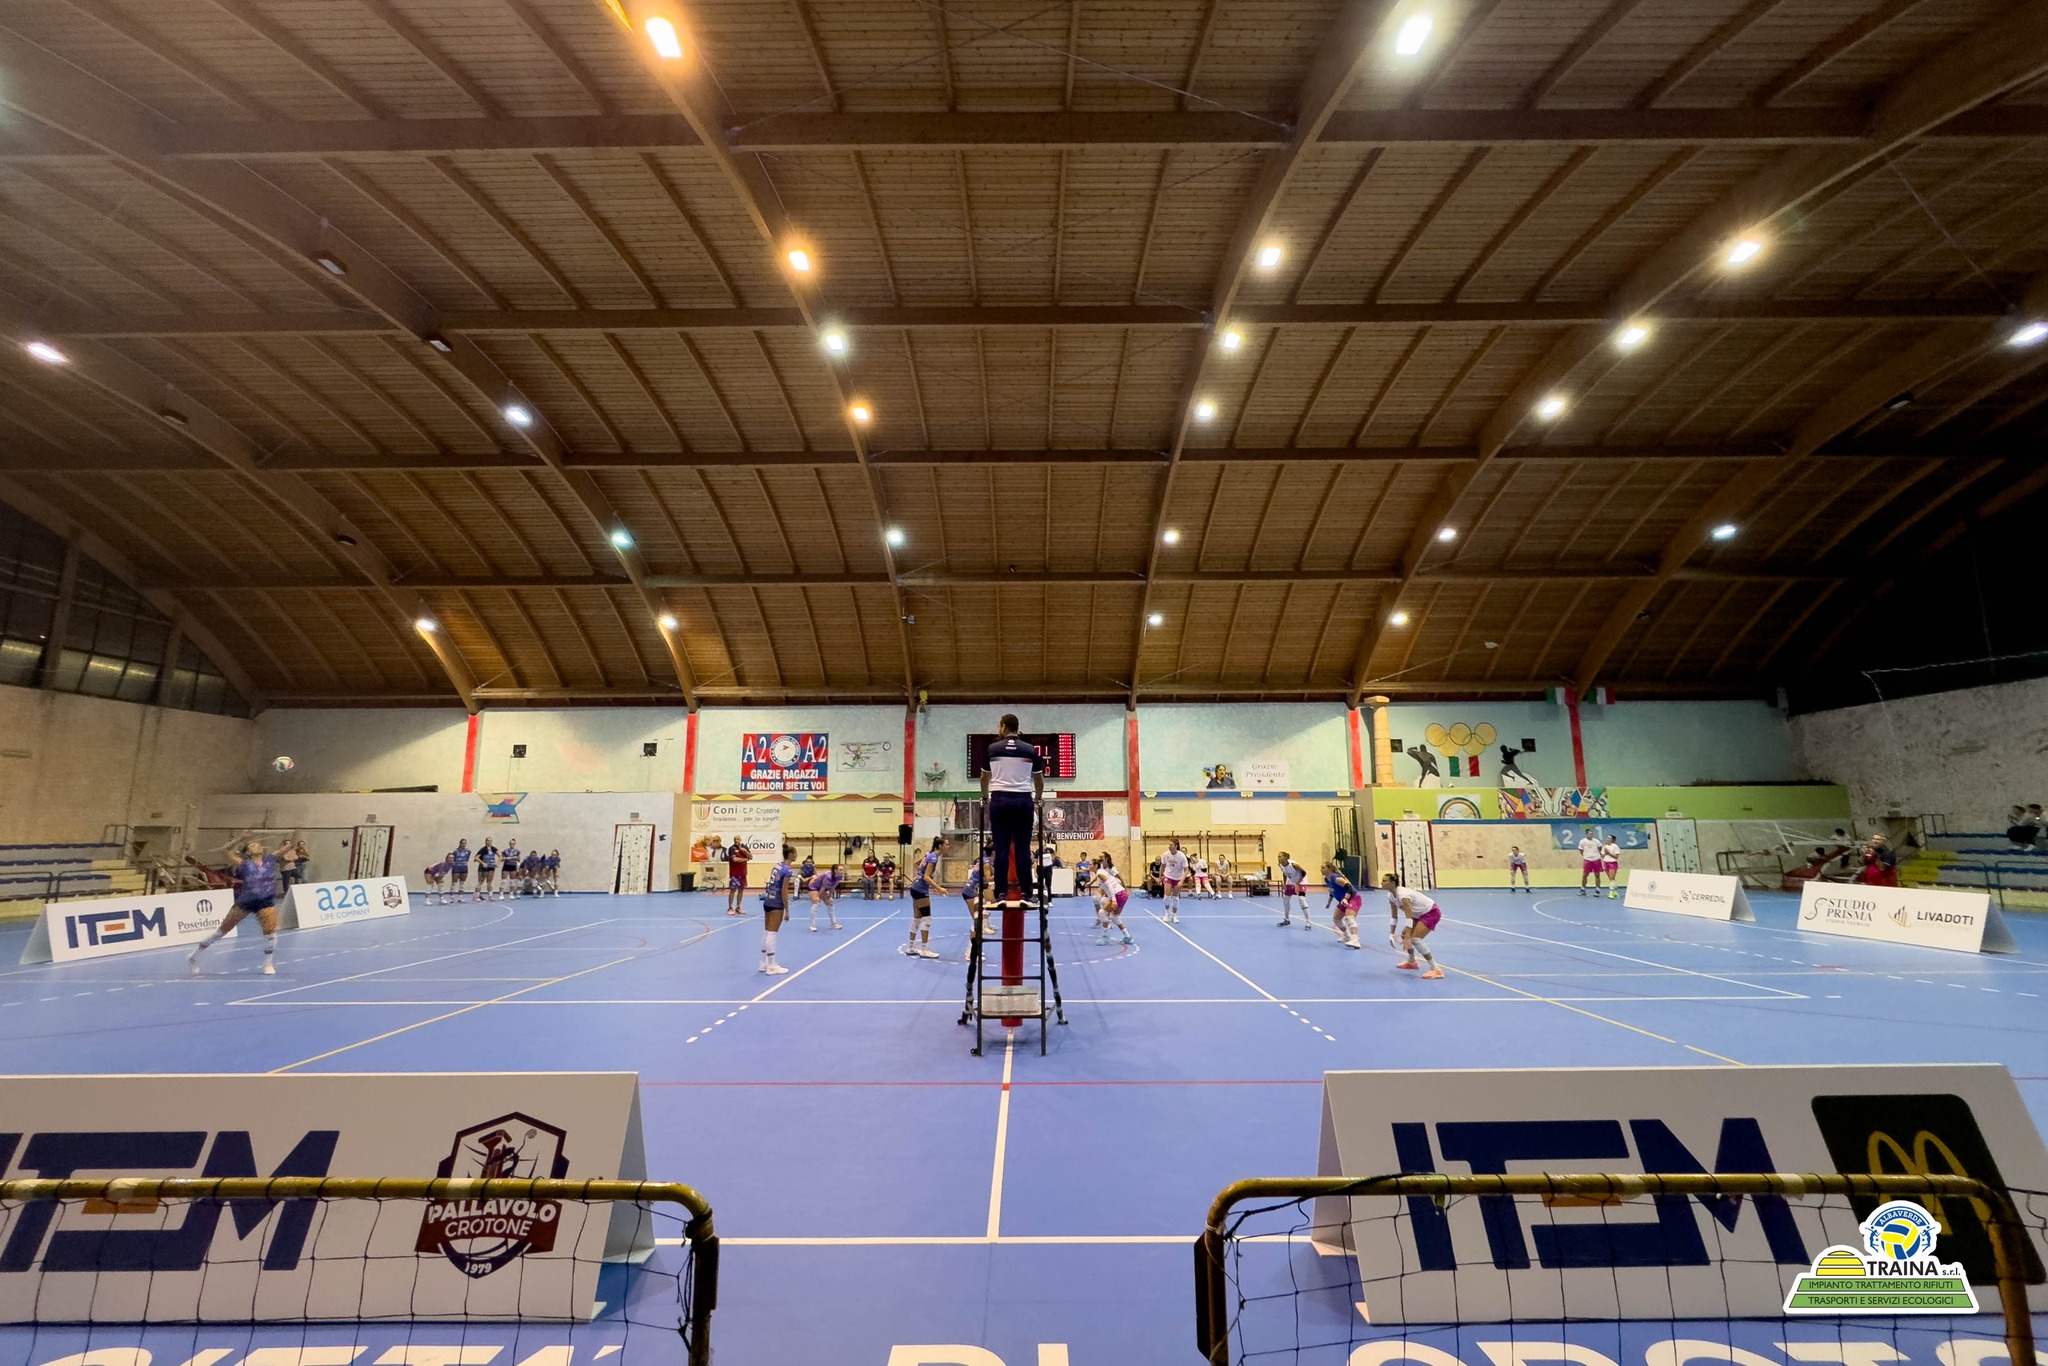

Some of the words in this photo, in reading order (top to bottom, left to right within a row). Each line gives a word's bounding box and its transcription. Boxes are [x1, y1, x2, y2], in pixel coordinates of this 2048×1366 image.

[743, 736, 767, 763] A2
[803, 735, 827, 763] A2
[750, 769, 782, 780] GRAZIE
[783, 769, 819, 779] RAGAZZI
[746, 782, 784, 790] MIGLIORI
[785, 781, 809, 790] SIETE
[810, 781, 825, 790] VOI
[713, 805, 738, 814] Coni
[1056, 832, 1095, 840] BENVENUTO
[1562, 829, 1574, 845] 2
[1595, 825, 1604, 841] 1
[1626, 830, 1638, 847] 3
[316, 884, 370, 911] a2a
[1691, 892, 1726, 903] CERREDIL
[1828, 898, 1876, 912] STUDIO
[320, 912, 335, 921] LIFE
[336, 908, 371, 919] COMPANY
[1827, 908, 1873, 922] PRISMA
[1916, 911, 1974, 926] LIVADOTI
[65, 907, 167, 949] ITEM
[178, 918, 221, 930] Poseidon
[1391, 1117, 1810, 1271] ITEM
[428, 1198, 557, 1224] PALLAVOLO
[444, 1218, 533, 1237] CROTONE
[464, 1262, 492, 1274] 1979
